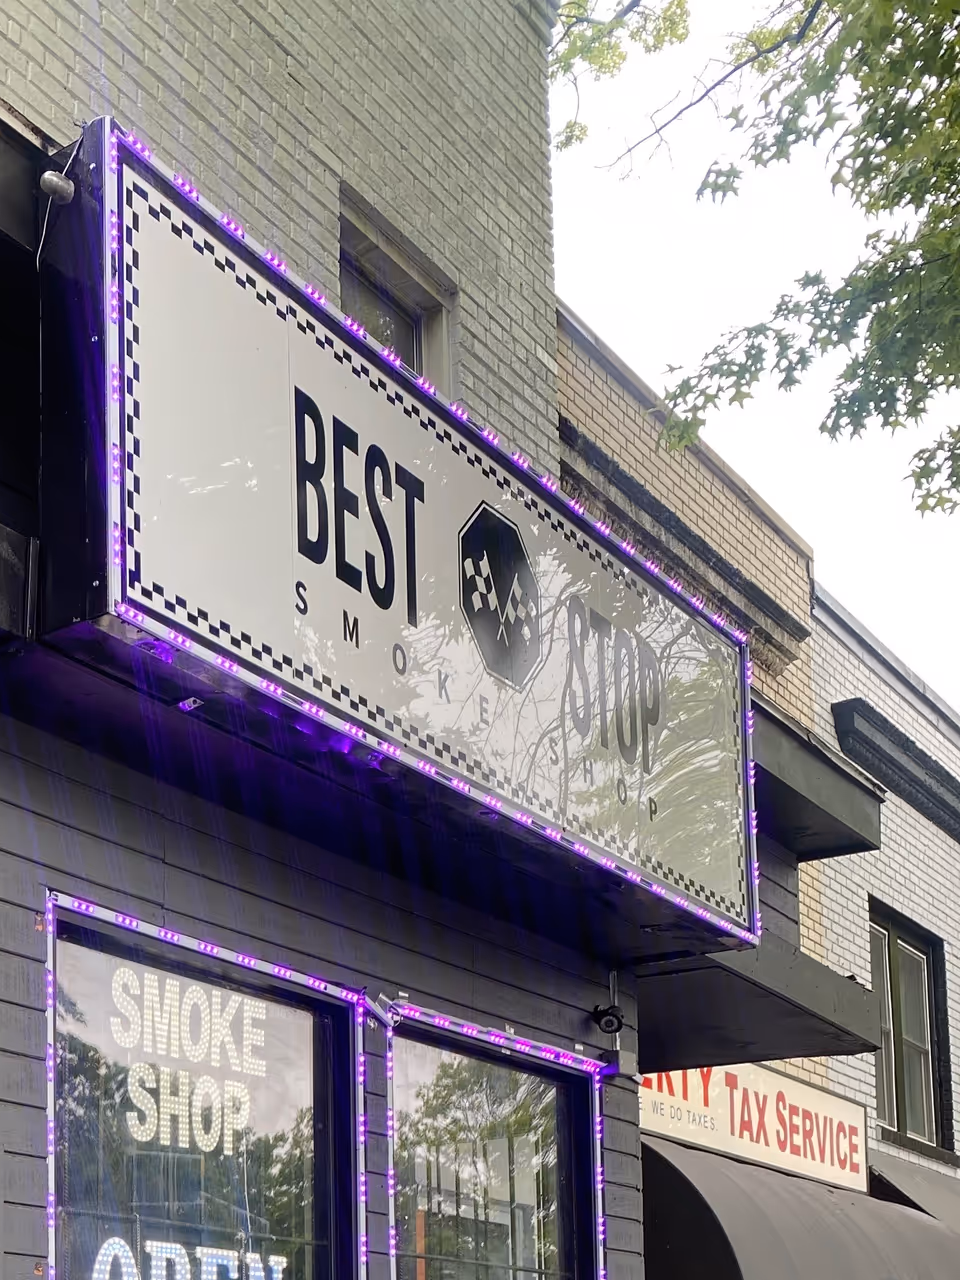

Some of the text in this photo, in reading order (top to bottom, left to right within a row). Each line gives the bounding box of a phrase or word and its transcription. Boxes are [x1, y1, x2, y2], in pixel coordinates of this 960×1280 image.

[294, 385, 660, 776] BEST STOP
[295, 580, 658, 822] SMOKE SHOP
[110, 967, 267, 1078] SMOKE
[126, 1062, 250, 1156] SHOP
[651, 1100, 665, 1117] WE
[669, 1105, 683, 1122] DO
[686, 1109, 719, 1132] TAXES.
[724, 1071, 770, 1148] TAX
[775, 1090, 860, 1174] SERVICE
